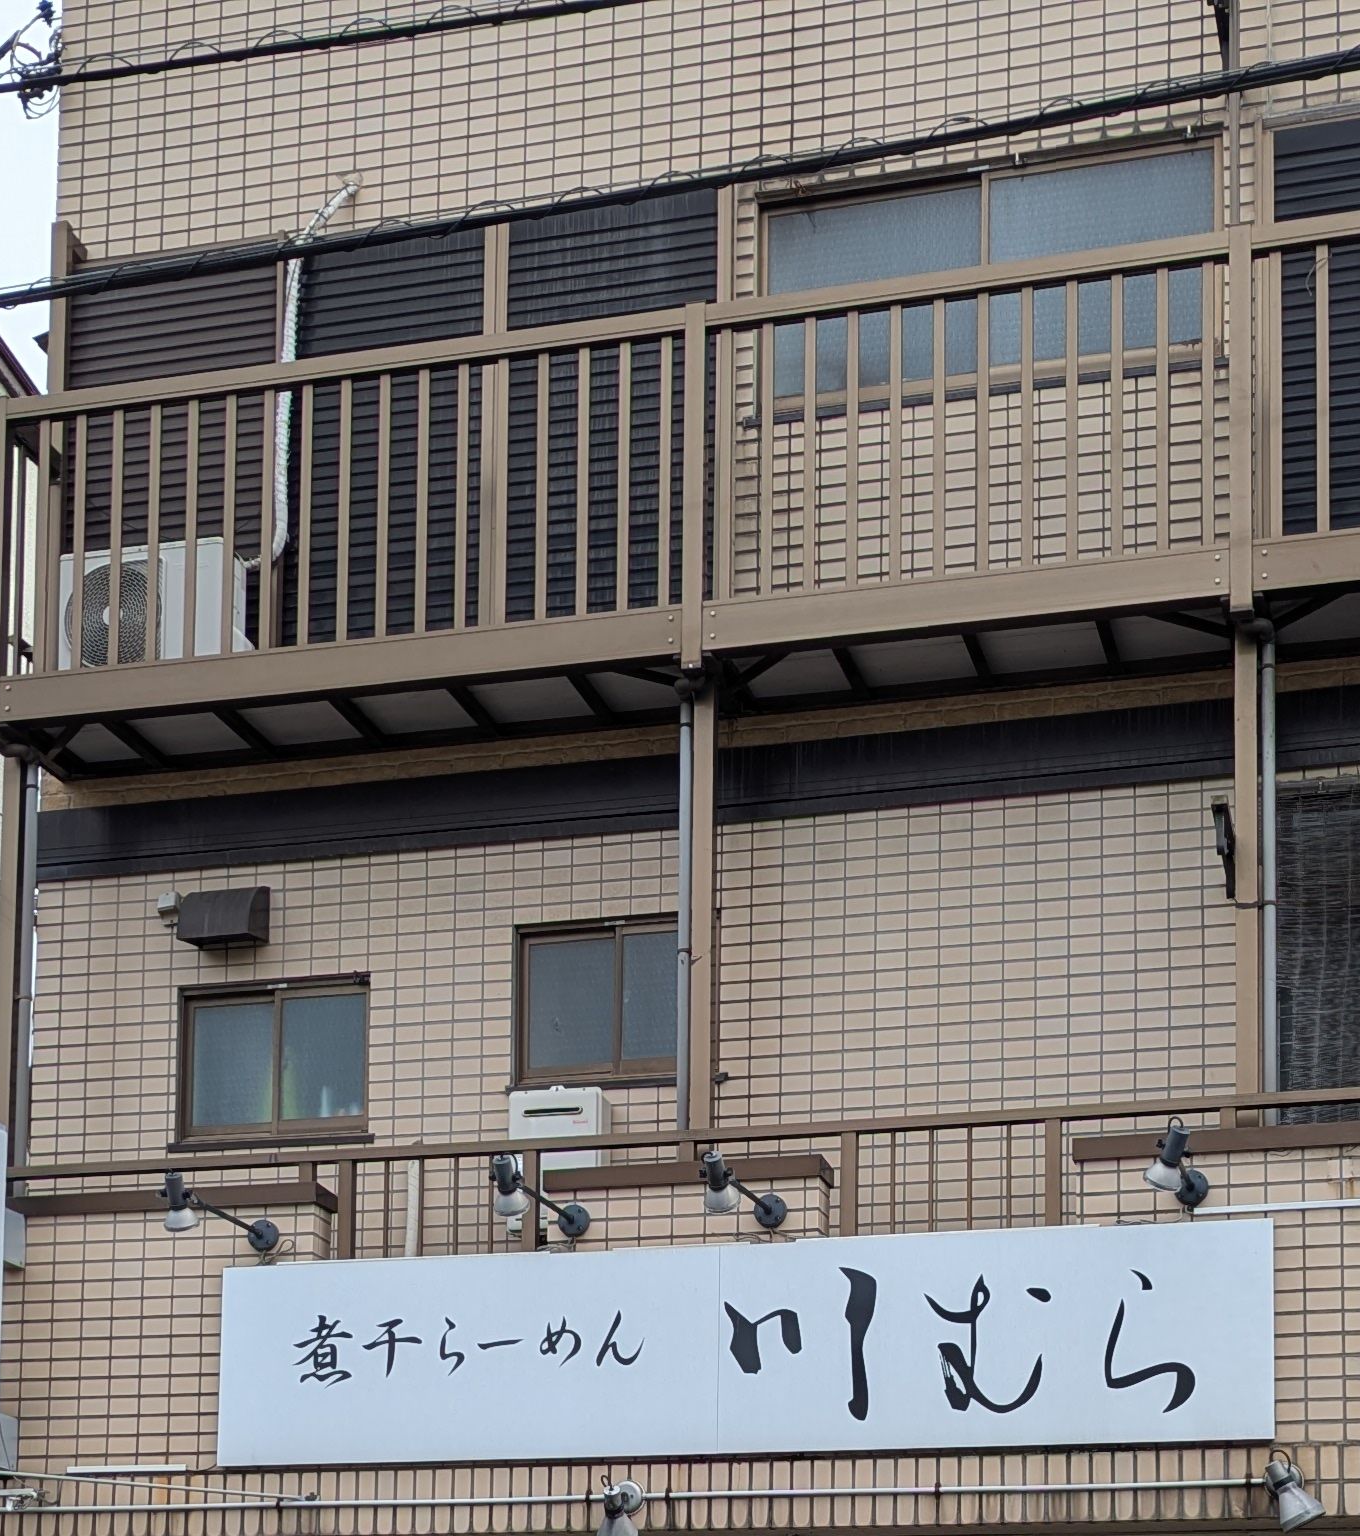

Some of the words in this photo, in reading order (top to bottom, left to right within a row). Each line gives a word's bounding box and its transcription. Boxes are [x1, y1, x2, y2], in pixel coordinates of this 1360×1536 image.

[292, 1309, 645, 1389] 煮干らーめん
[724, 1265, 1197, 1422] 川むら
